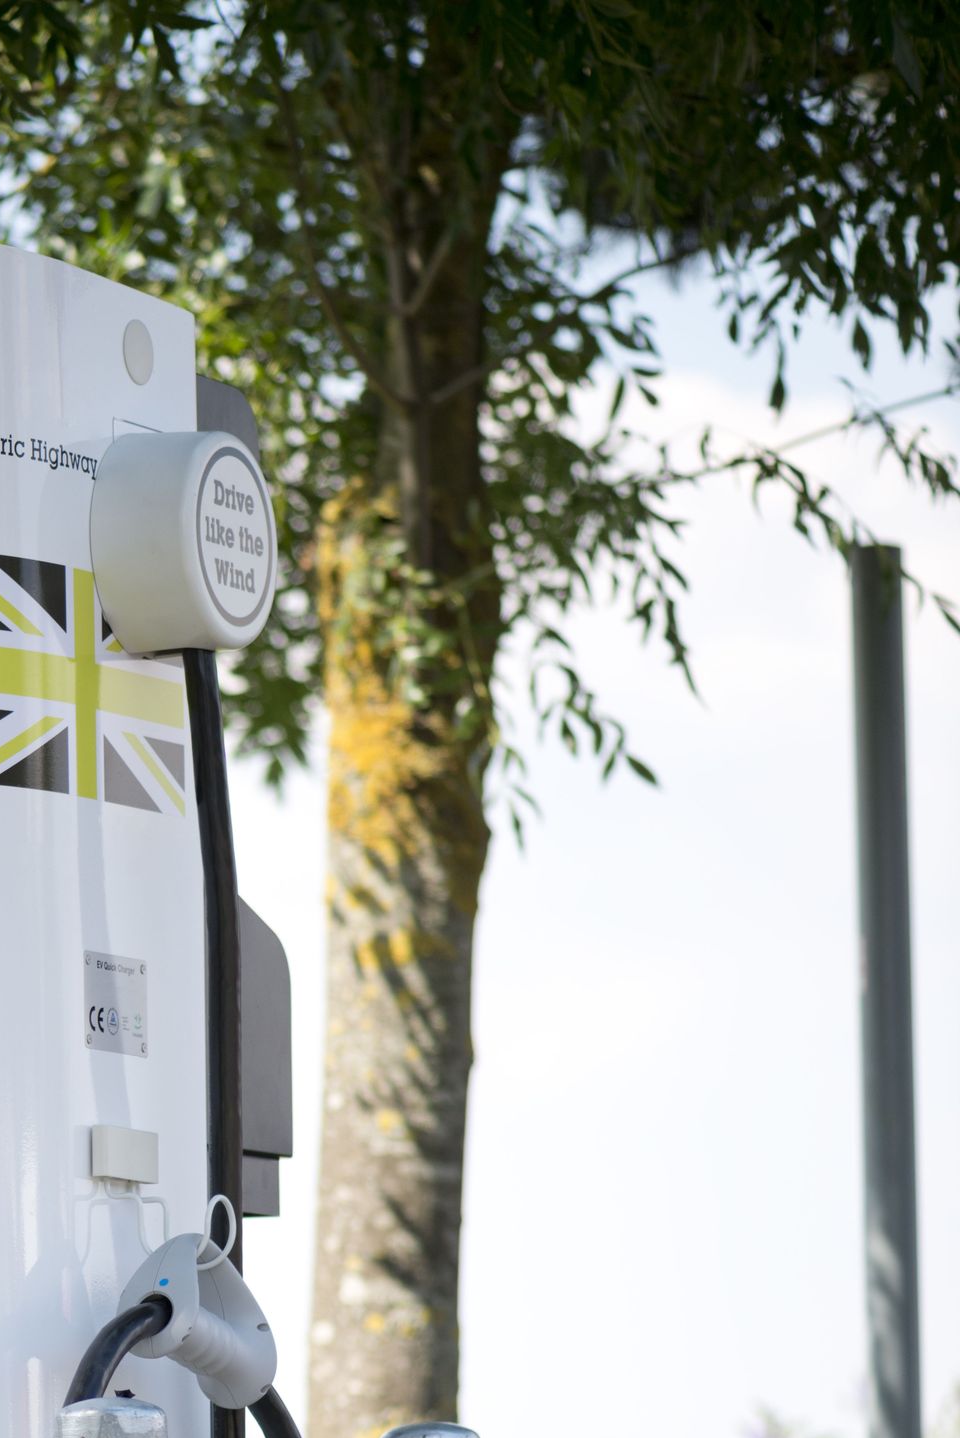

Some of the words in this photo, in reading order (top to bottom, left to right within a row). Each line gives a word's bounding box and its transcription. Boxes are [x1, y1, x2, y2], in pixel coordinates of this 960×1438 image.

[30, 438, 98, 480] Highway
[213, 479, 254, 516] Drive
[205, 516, 234, 548] like
[239, 526, 263, 557] the
[214, 557, 255, 594] Wind
[89, 1006, 104, 1033] CE
